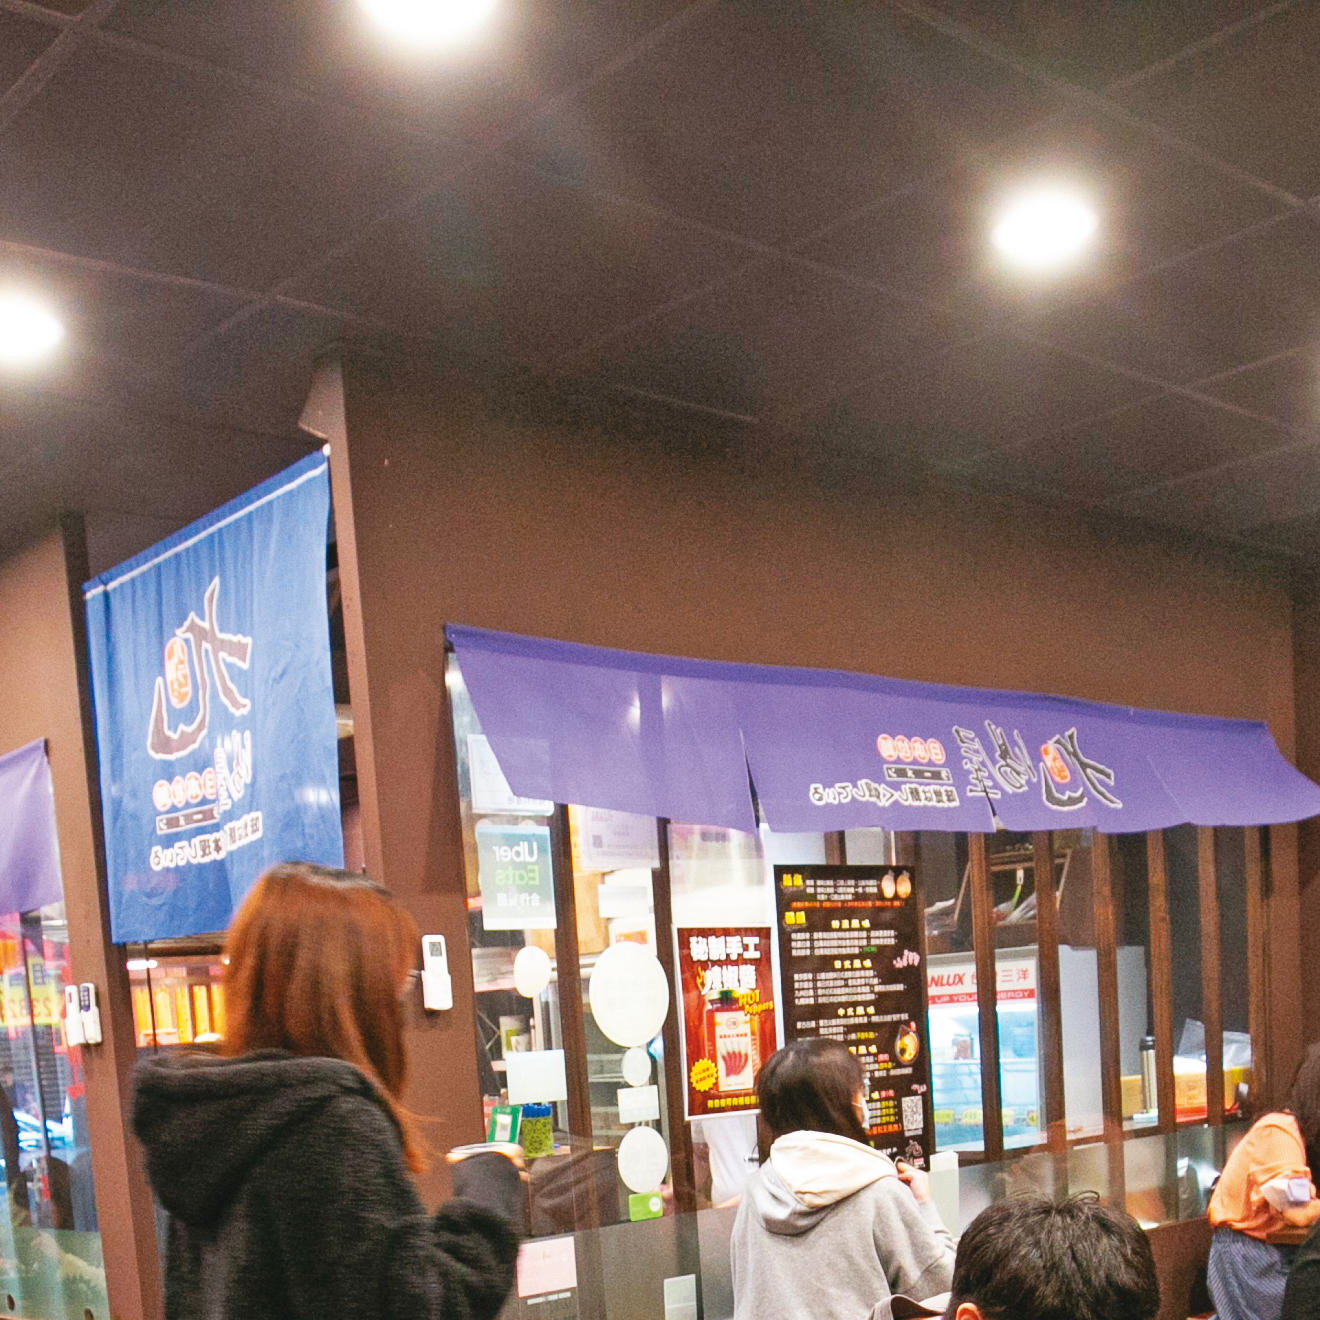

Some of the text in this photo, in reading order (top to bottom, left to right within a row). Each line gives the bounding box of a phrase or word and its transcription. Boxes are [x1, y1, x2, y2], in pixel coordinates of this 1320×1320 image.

[927, 973, 966, 988] NLUX
[971, 968, 1029, 985] 台三洋
[739, 989, 761, 1008] HOT
[996, 990, 1030, 999] NERGY
